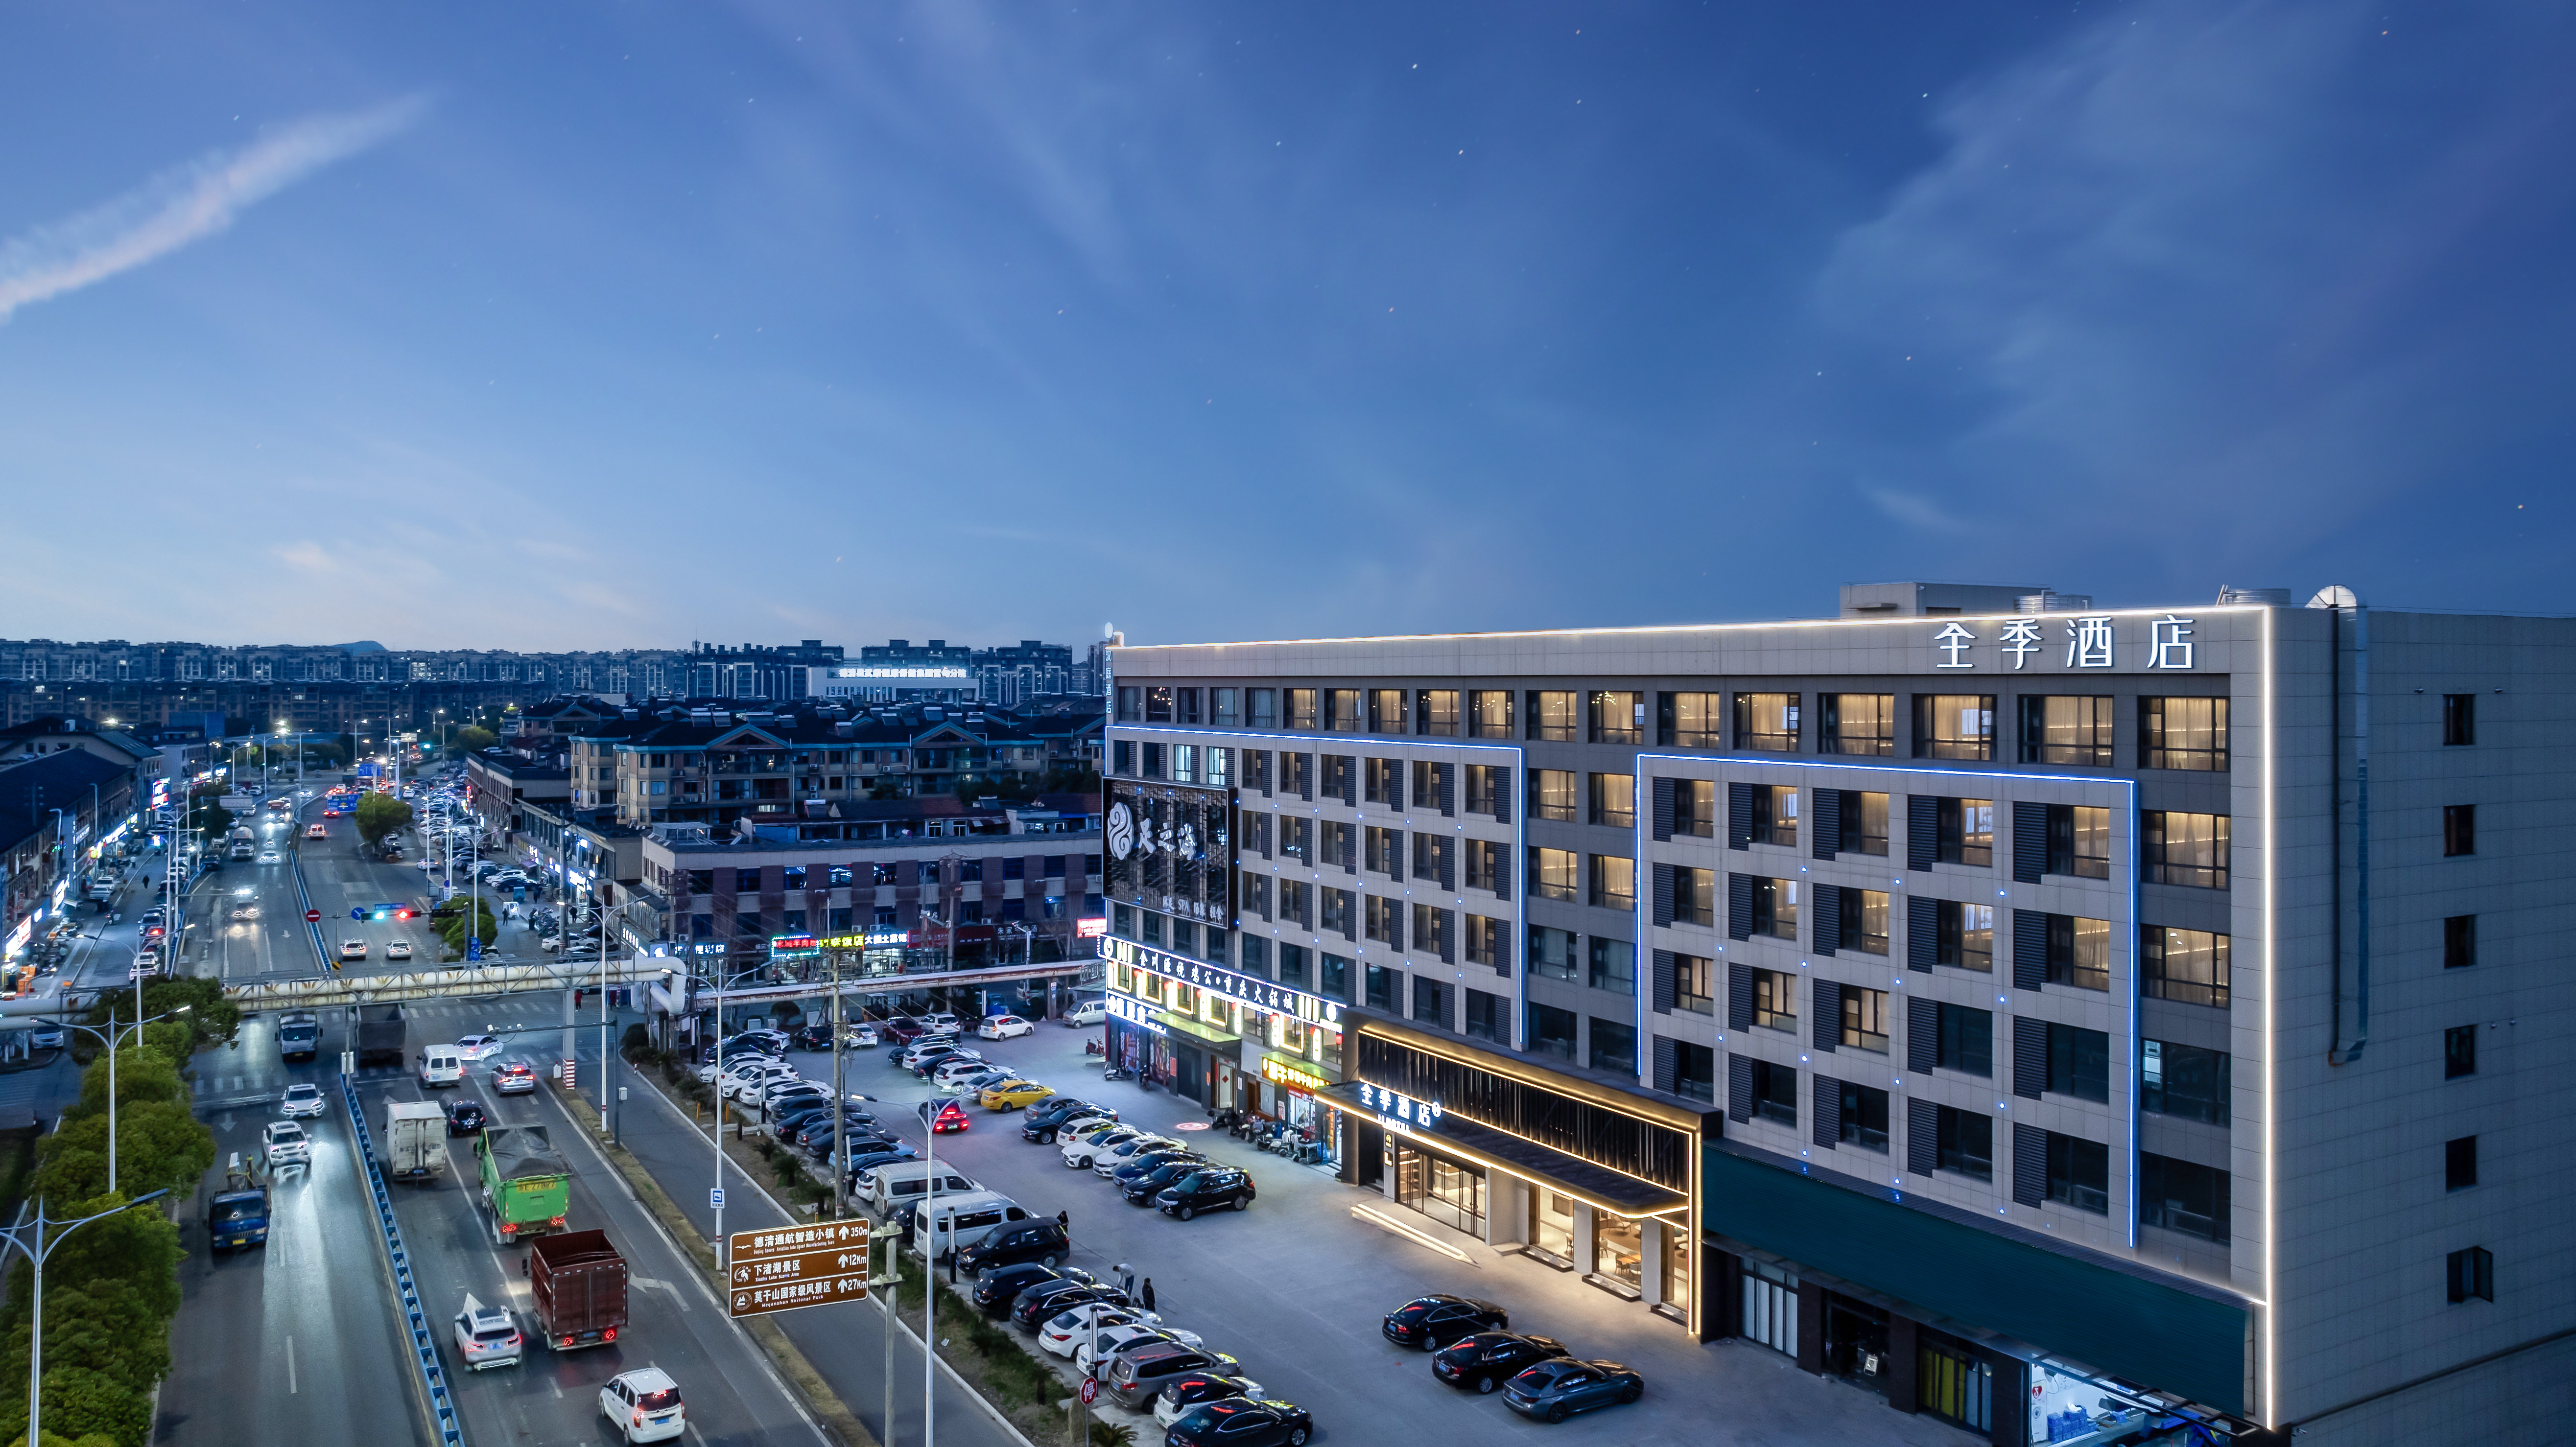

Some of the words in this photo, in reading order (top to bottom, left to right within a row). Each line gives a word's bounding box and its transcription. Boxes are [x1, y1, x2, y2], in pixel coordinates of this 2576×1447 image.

[1934, 614, 2194, 670] 全季酒店
[1178, 899, 1191, 912] SPA
[1361, 1083, 1430, 1127] 全季酒店
[754, 1228, 835, 1248] 德清通航智造小镇
[851, 1226, 868, 1237] 350m
[754, 1260, 801, 1277] 下渚湖景区
[850, 1254, 867, 1266] 12Km
[754, 1282, 831, 1304] 莫干山国家级风景区
[848, 1279, 867, 1291] 27Km
[1084, 1381, 1095, 1401] 停
